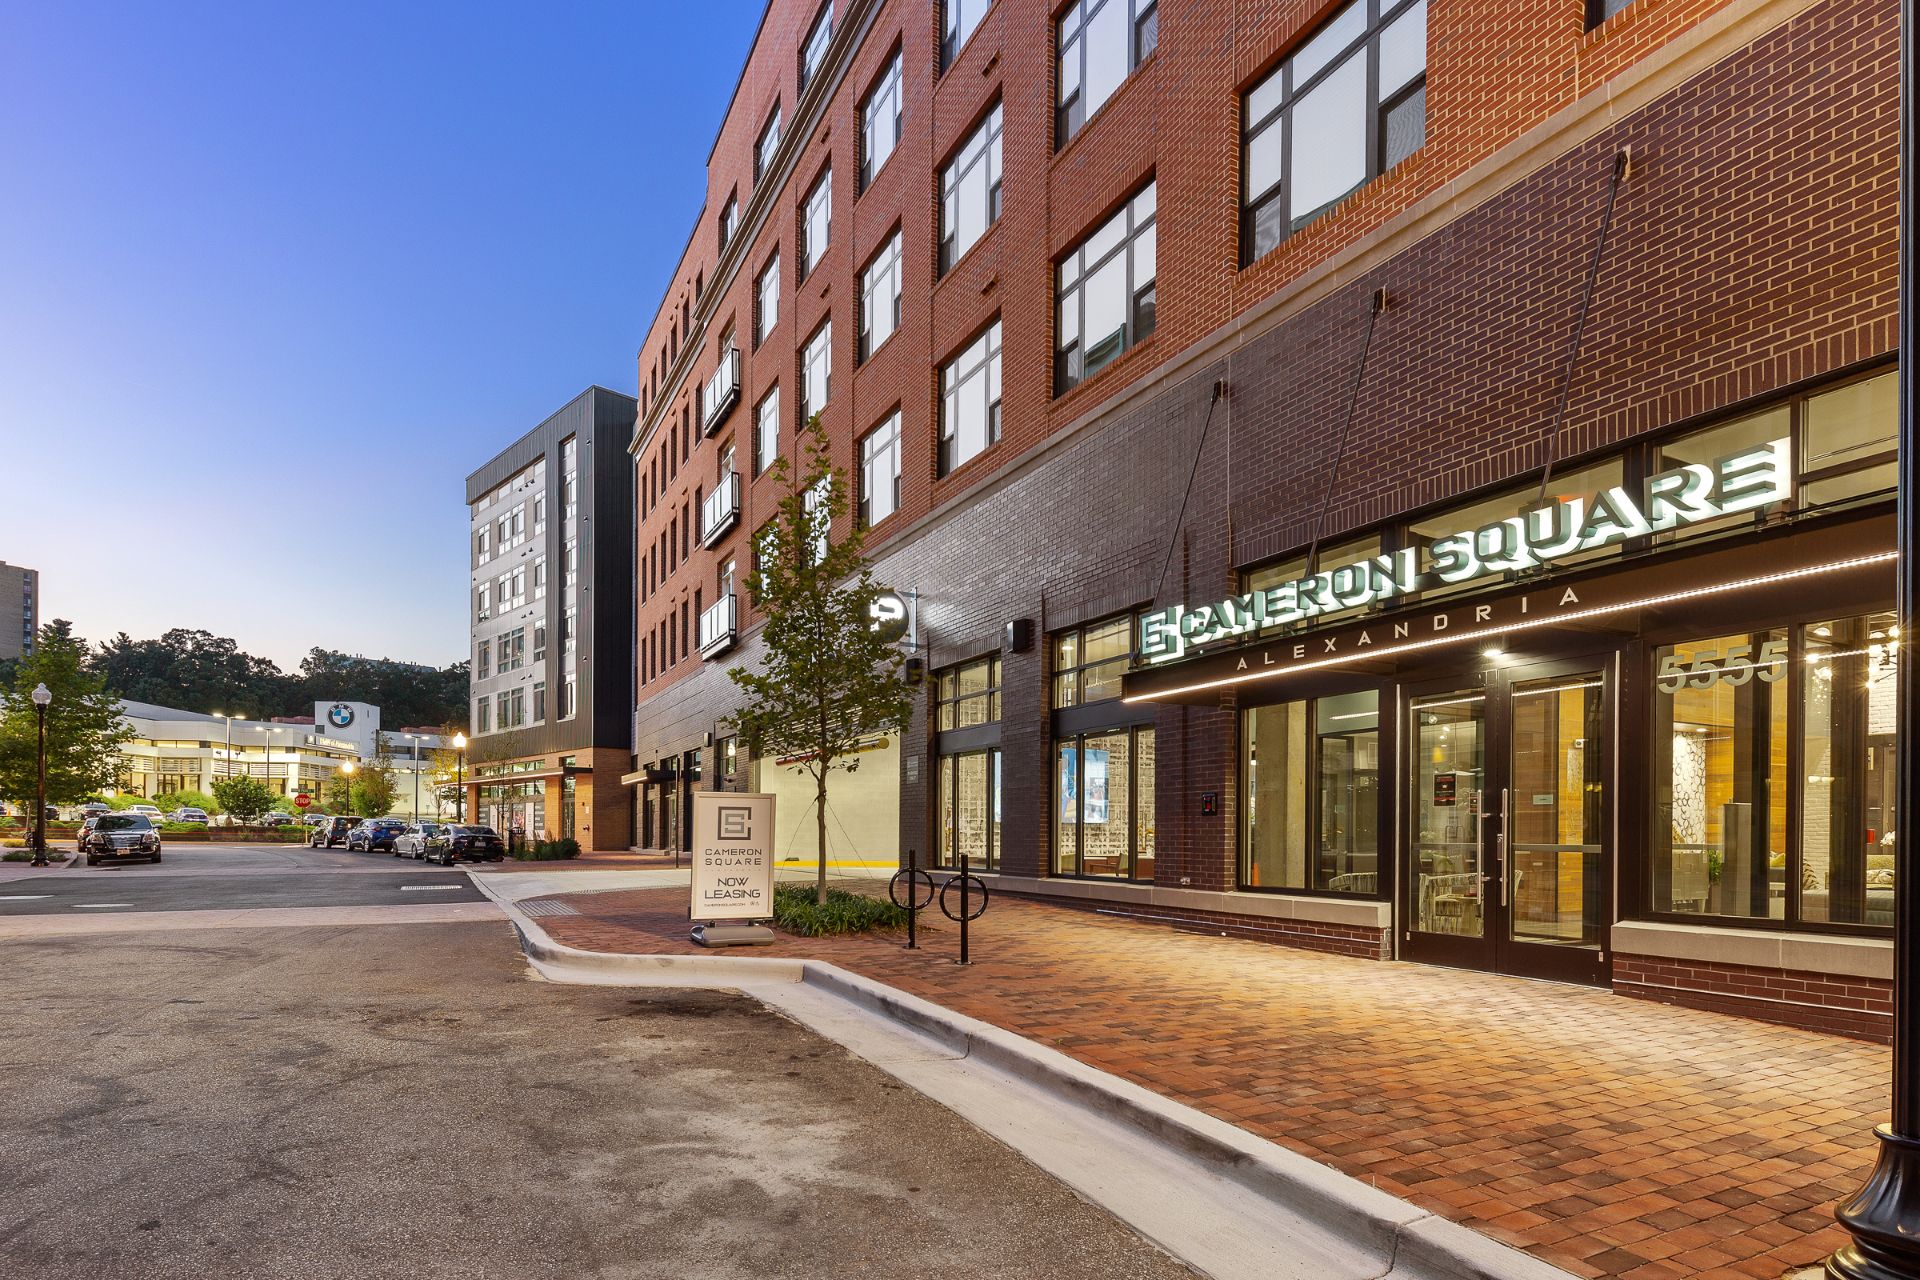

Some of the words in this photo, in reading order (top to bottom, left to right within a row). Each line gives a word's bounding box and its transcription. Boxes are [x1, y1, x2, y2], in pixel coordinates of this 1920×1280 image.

[1180, 546, 1416, 646] CAMERON
[1428, 437, 1791, 583] SQUARE
[1237, 586, 1579, 670] ALEXANDRIA
[1658, 640, 1788, 694] 5555
[705, 858, 762, 866] SQUARE
[705, 889, 760, 899] LEASING
[717, 877, 749, 886] NOW
